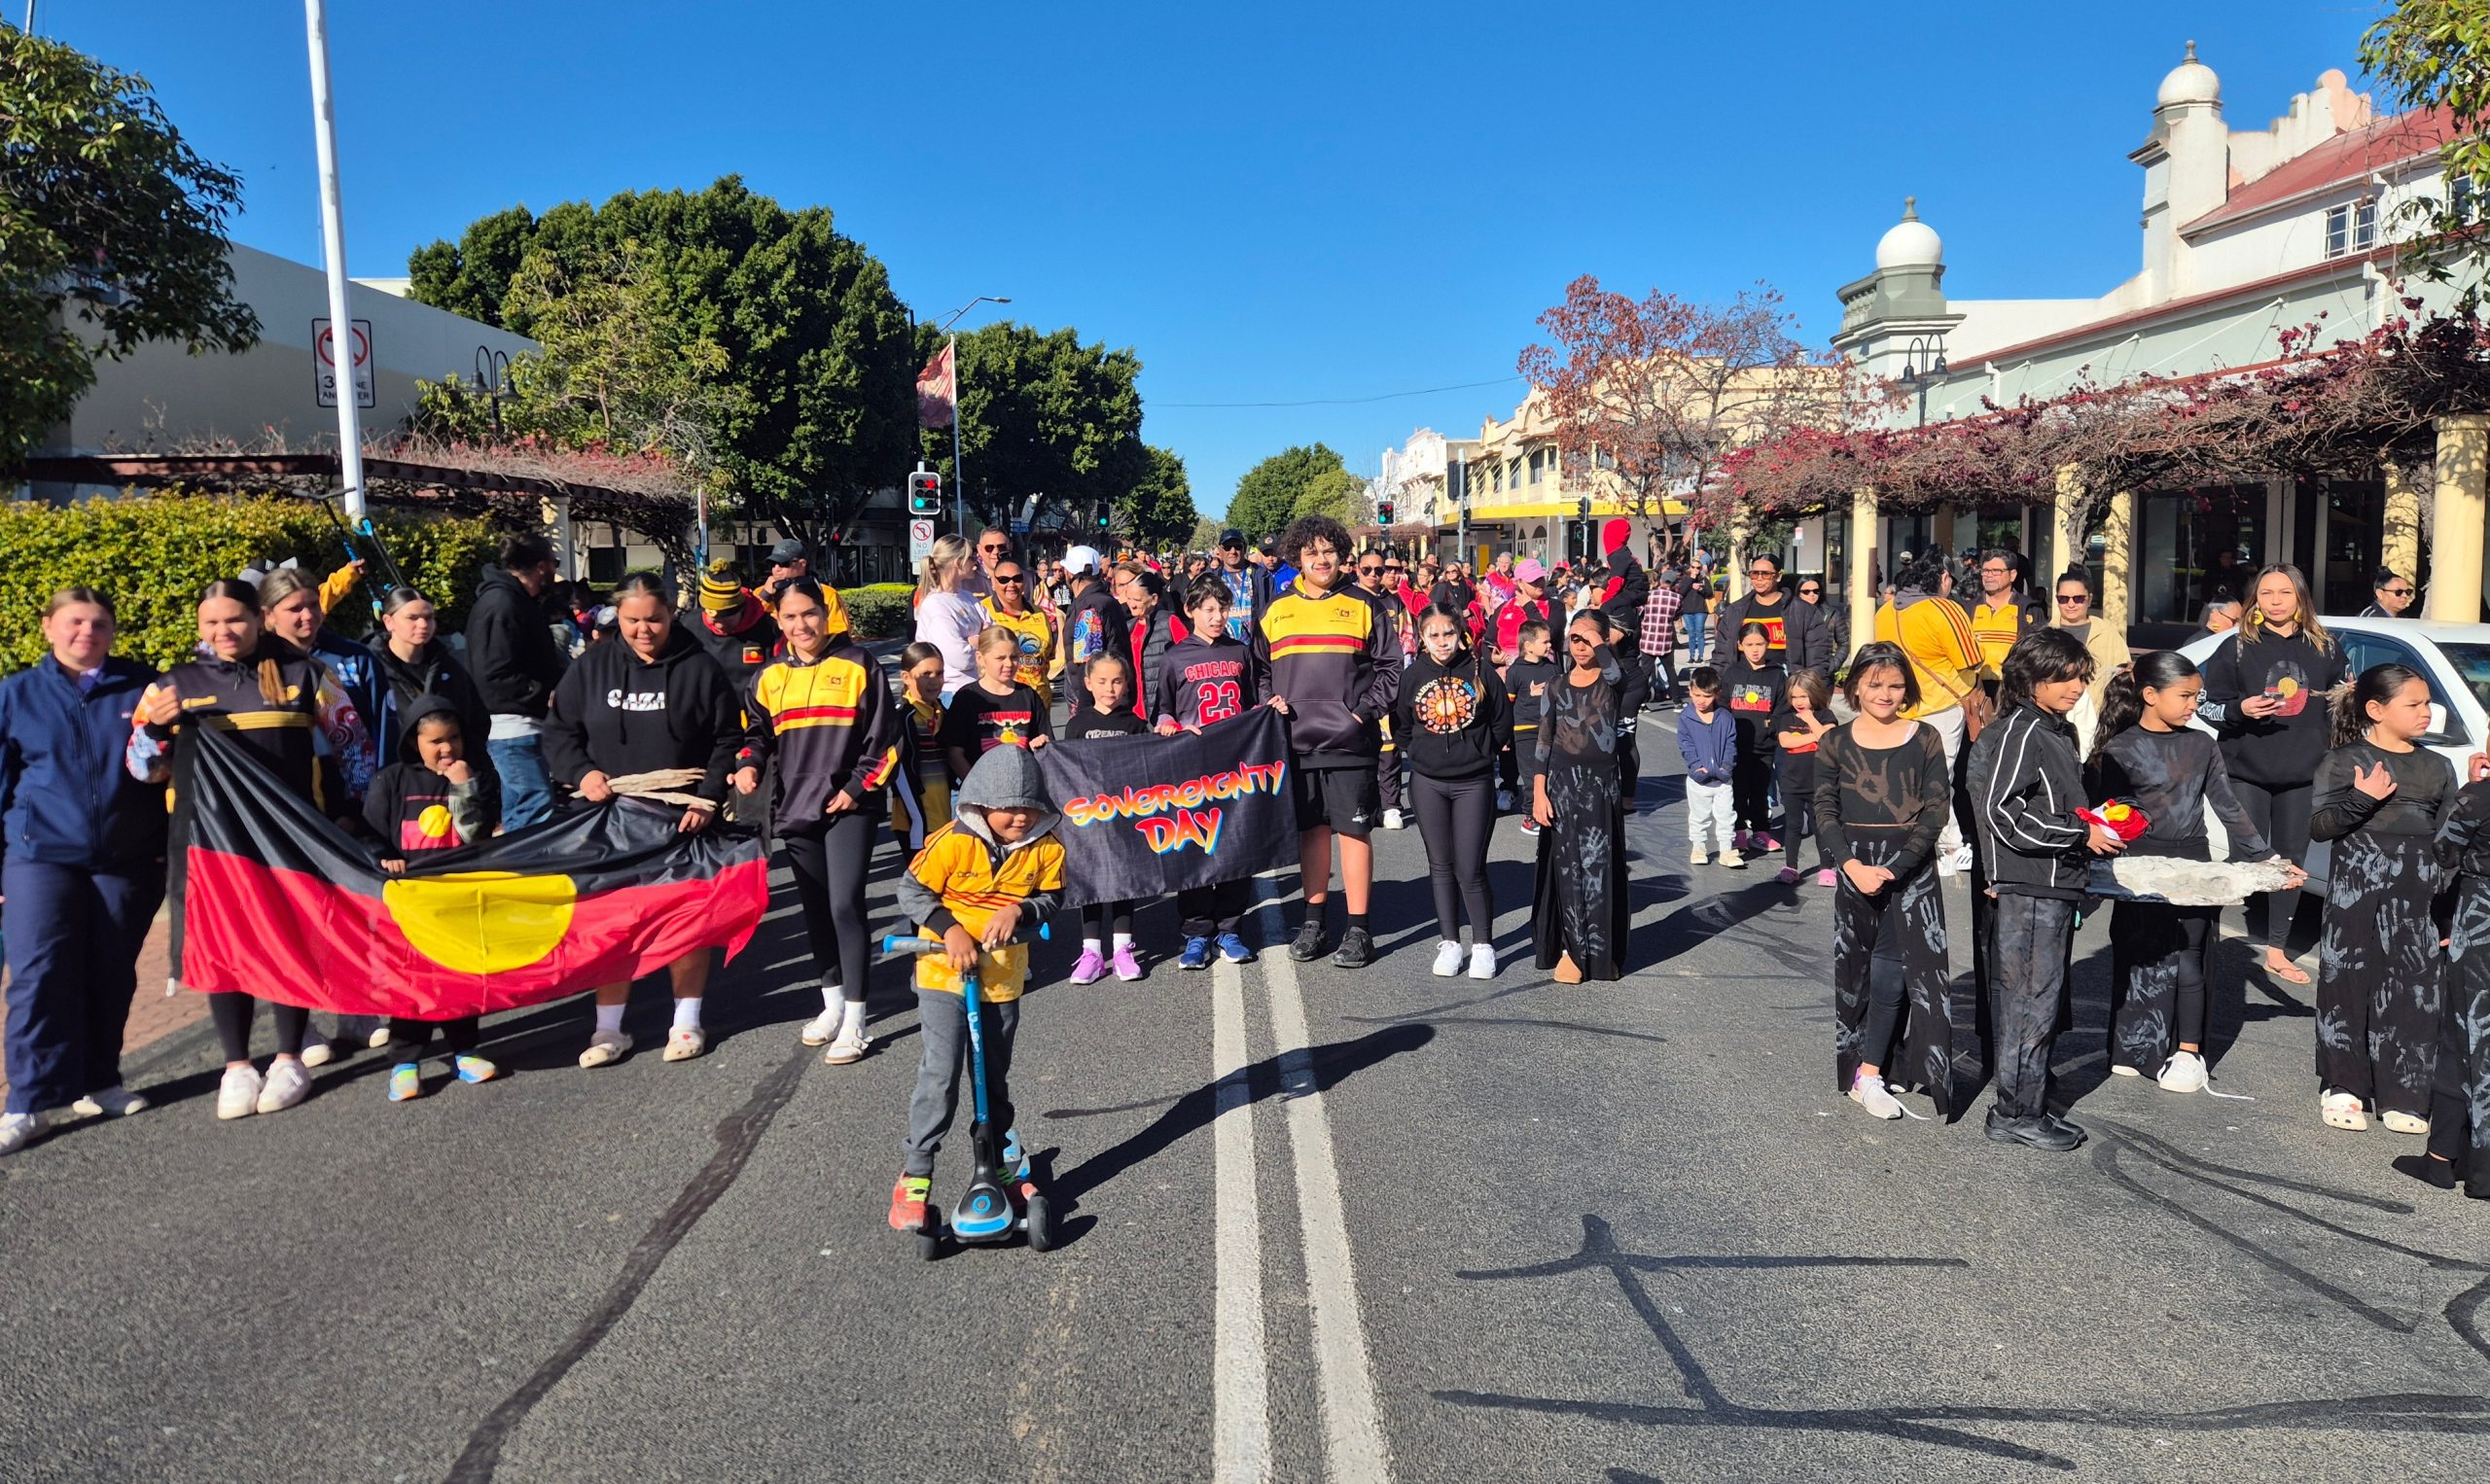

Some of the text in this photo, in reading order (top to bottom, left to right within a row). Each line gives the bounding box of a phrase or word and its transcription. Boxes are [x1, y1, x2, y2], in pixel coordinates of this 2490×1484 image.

[322, 391, 337, 400] AN
[1197, 680, 1242, 726] 23
[1414, 679, 1440, 703] NAIDOC
[1063, 760, 1285, 827] SOVEREIGNTY
[1135, 807, 1223, 855] DAY
